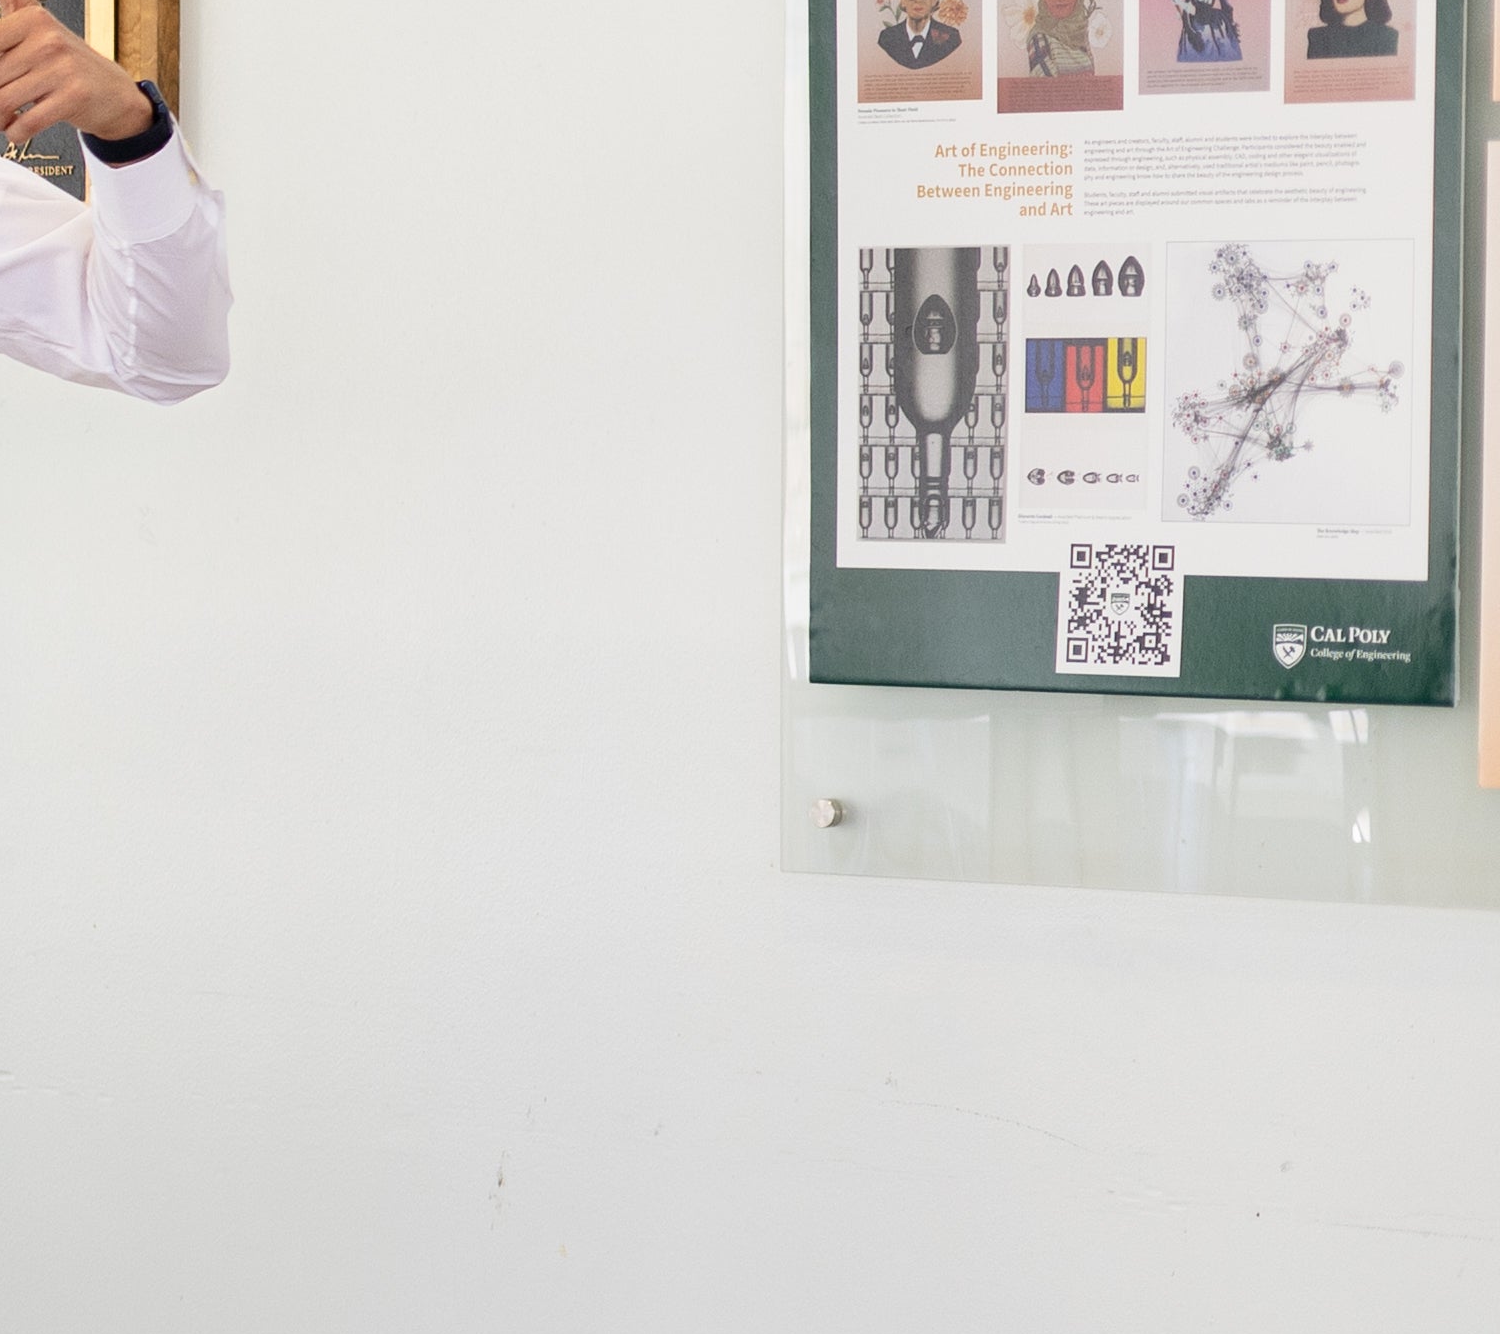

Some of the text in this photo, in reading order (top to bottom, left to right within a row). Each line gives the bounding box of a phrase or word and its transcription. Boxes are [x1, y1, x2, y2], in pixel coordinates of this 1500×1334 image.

[934, 140, 1073, 161] Art of Engineering:
[958, 161, 1074, 178] The Connection
[916, 181, 1074, 201] Between Engineering
[1019, 201, 1047, 217] and
[1050, 201, 1074, 216] Art
[1310, 625, 1391, 644] CAL POLY
[1310, 647, 1412, 664] College of Engineering
